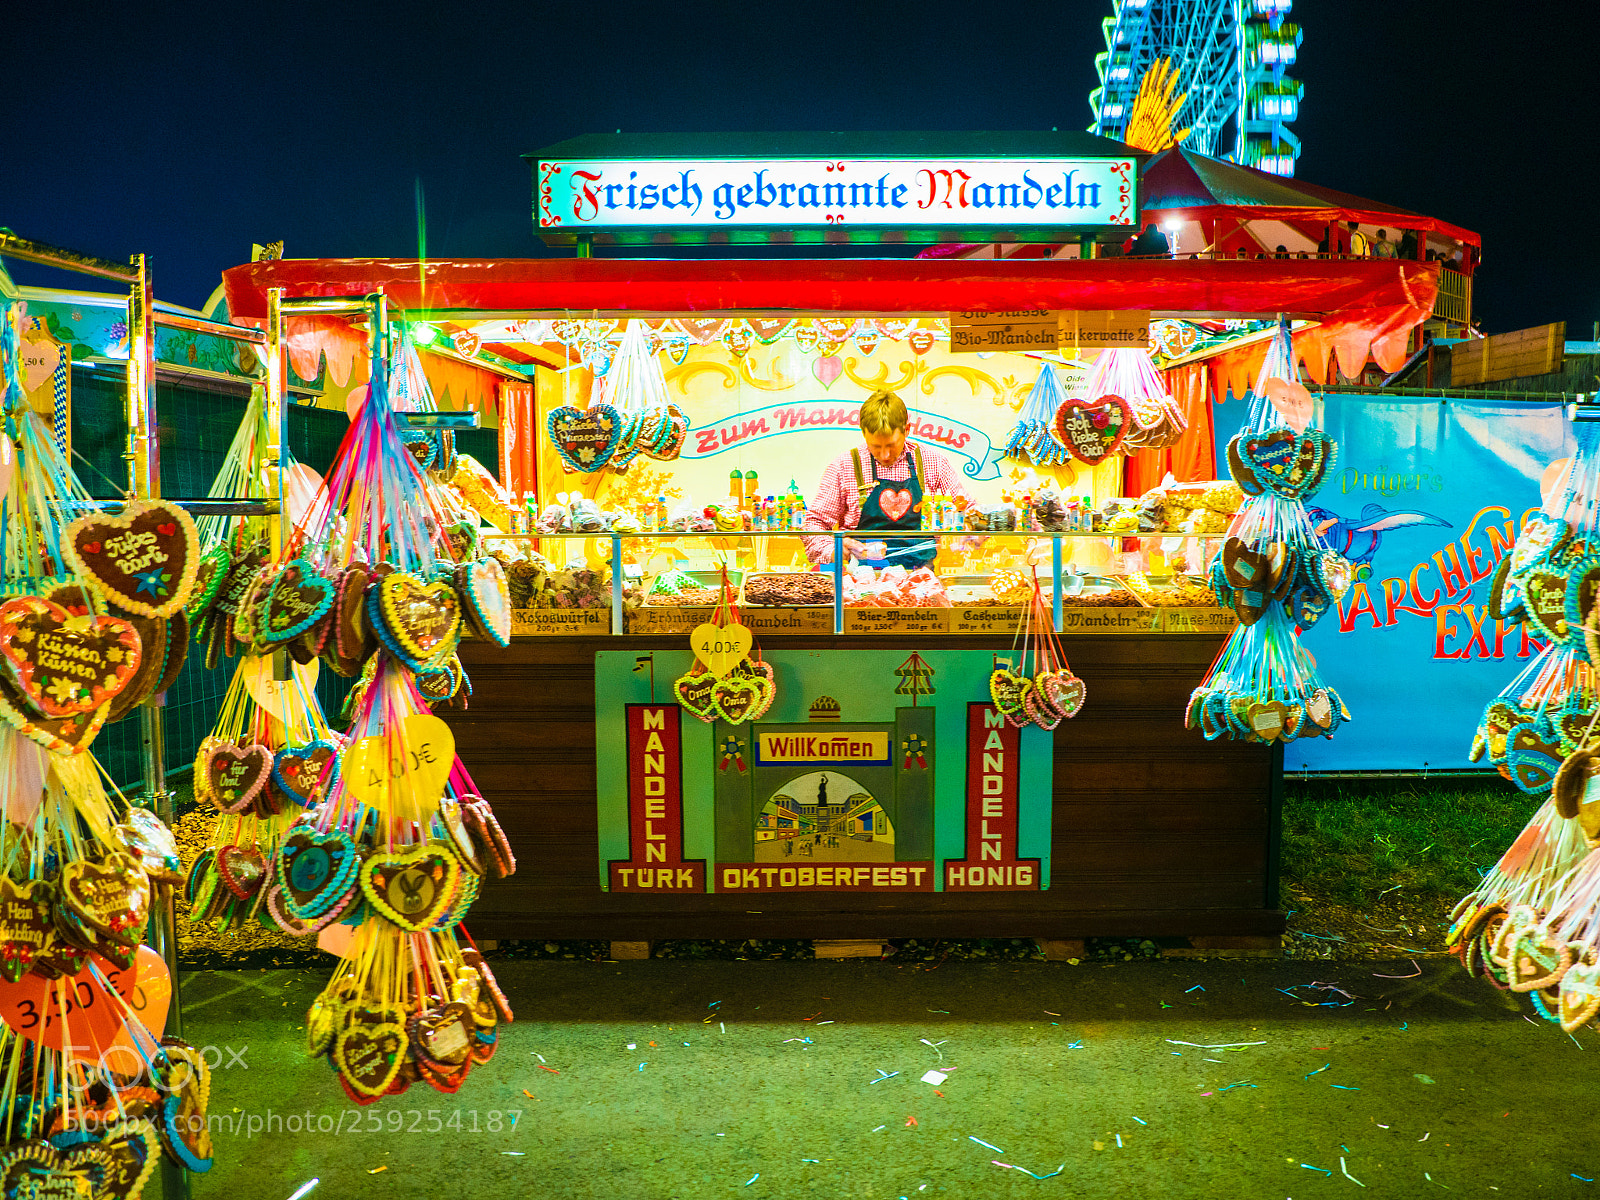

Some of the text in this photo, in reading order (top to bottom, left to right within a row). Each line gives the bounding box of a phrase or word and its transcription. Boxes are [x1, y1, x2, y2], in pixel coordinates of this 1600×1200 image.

[569, 168, 1102, 224] Frisch gebrannte Mandeln
[954, 329, 1055, 346] Bio-Mandeln
[694, 417, 771, 454] Zum
[1070, 429, 1099, 446] liebe
[1079, 444, 1105, 457] Dich
[1334, 464, 1444, 498] Dräger's
[515, 611, 600, 625] Kokoswürfel
[740, 614, 802, 628] Mandeln
[856, 610, 938, 621] Bier-Mandeln
[1067, 612, 1131, 628] Mandeln
[1169, 613, 1236, 626] Nuss-Mix
[701, 641, 741, 655] 4,00€
[688, 686, 711, 700] Oma
[723, 696, 747, 707] Oma
[230, 760, 249, 775] für
[303, 758, 323, 775] für
[219, 775, 241, 788] Omi
[297, 773, 320, 790] Opa
[641, 708, 667, 863] MANDELN
[980, 708, 1005, 862] MANDELN
[617, 865, 1033, 889] TÜRK OKTOBERFEST HONIG
